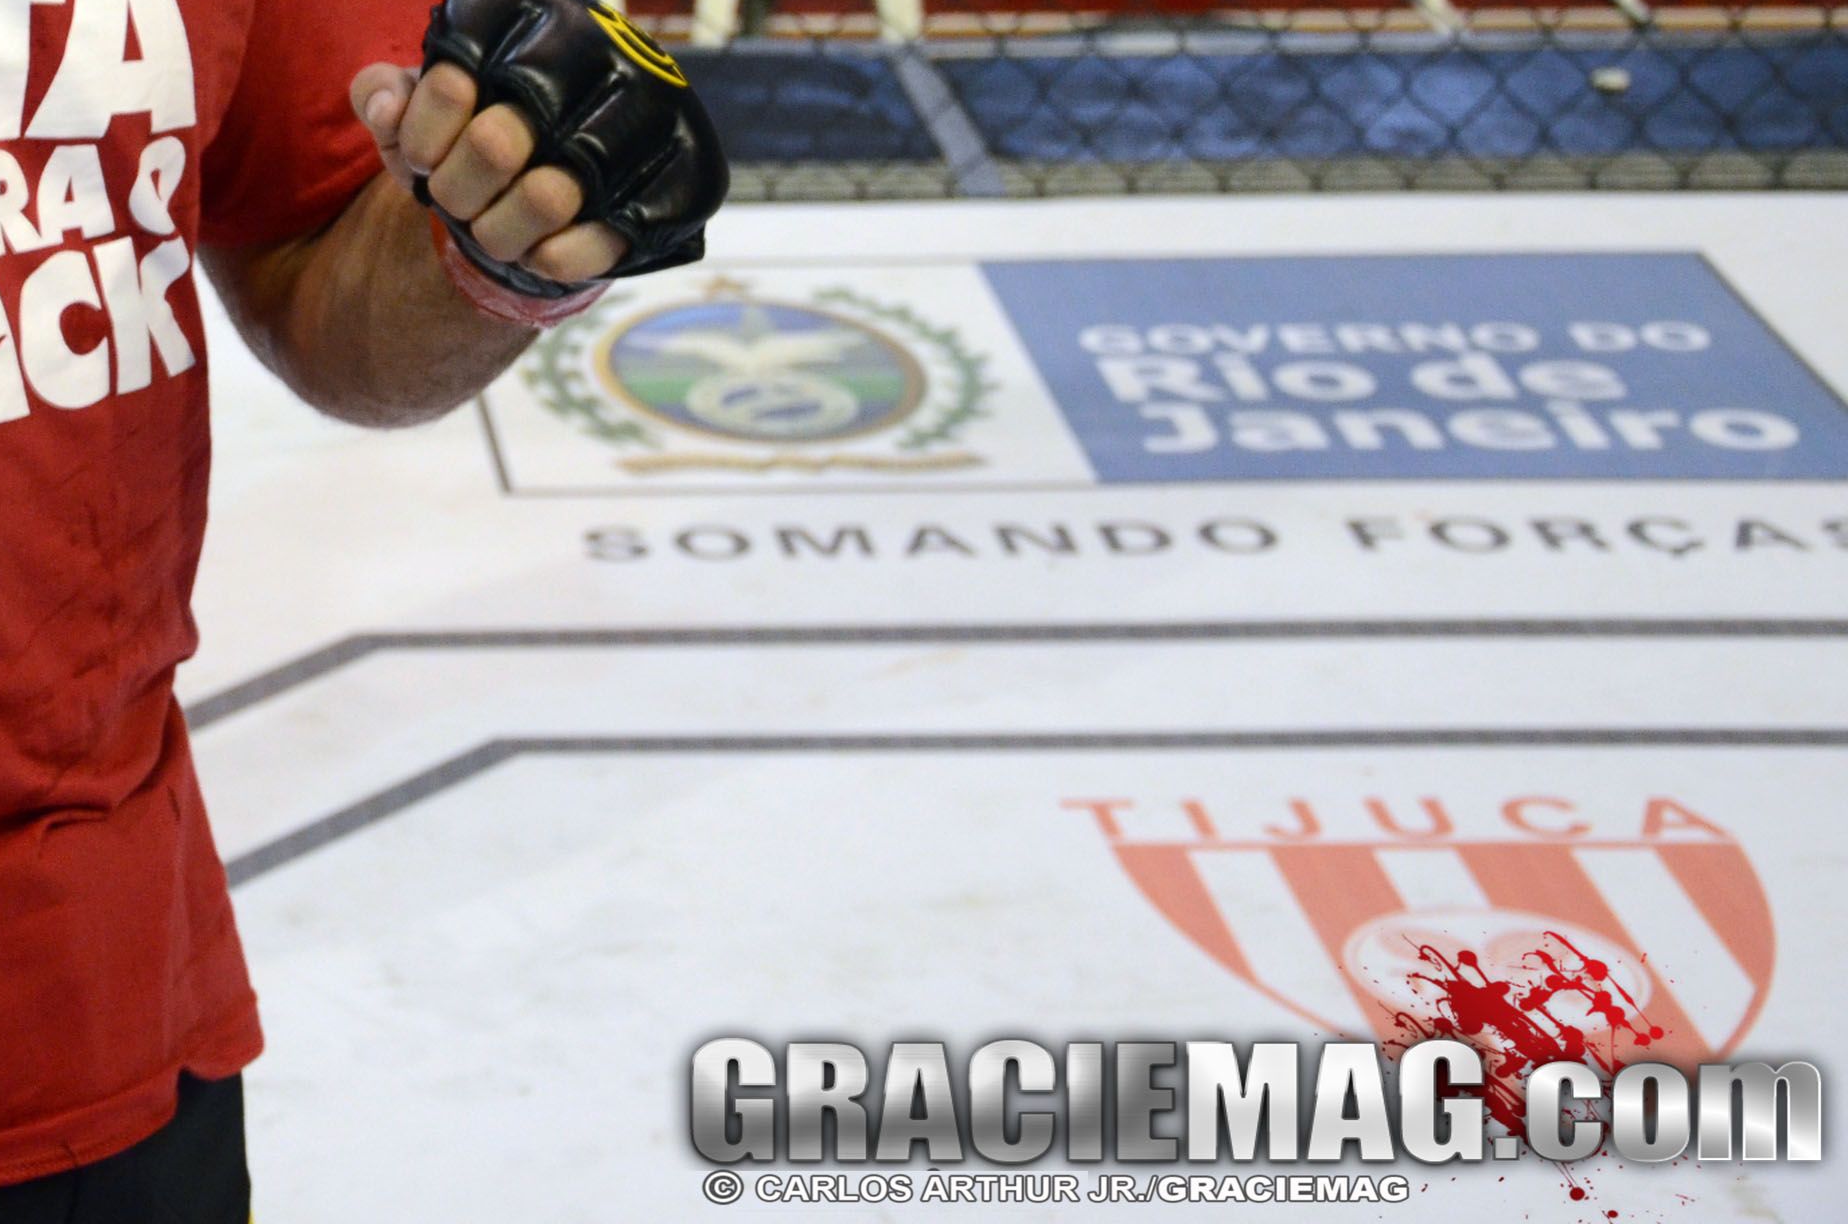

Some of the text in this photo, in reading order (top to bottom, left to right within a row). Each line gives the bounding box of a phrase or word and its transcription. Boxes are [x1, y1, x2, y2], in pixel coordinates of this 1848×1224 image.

[128, 135, 187, 236] O
[1078, 320, 1712, 356] GOVERNO DO
[1096, 349, 1629, 404] Rio de
[1142, 399, 1801, 454] Janeiro
[582, 522, 1280, 560] SOMANDO
[1059, 796, 1734, 842] TIJUCA
